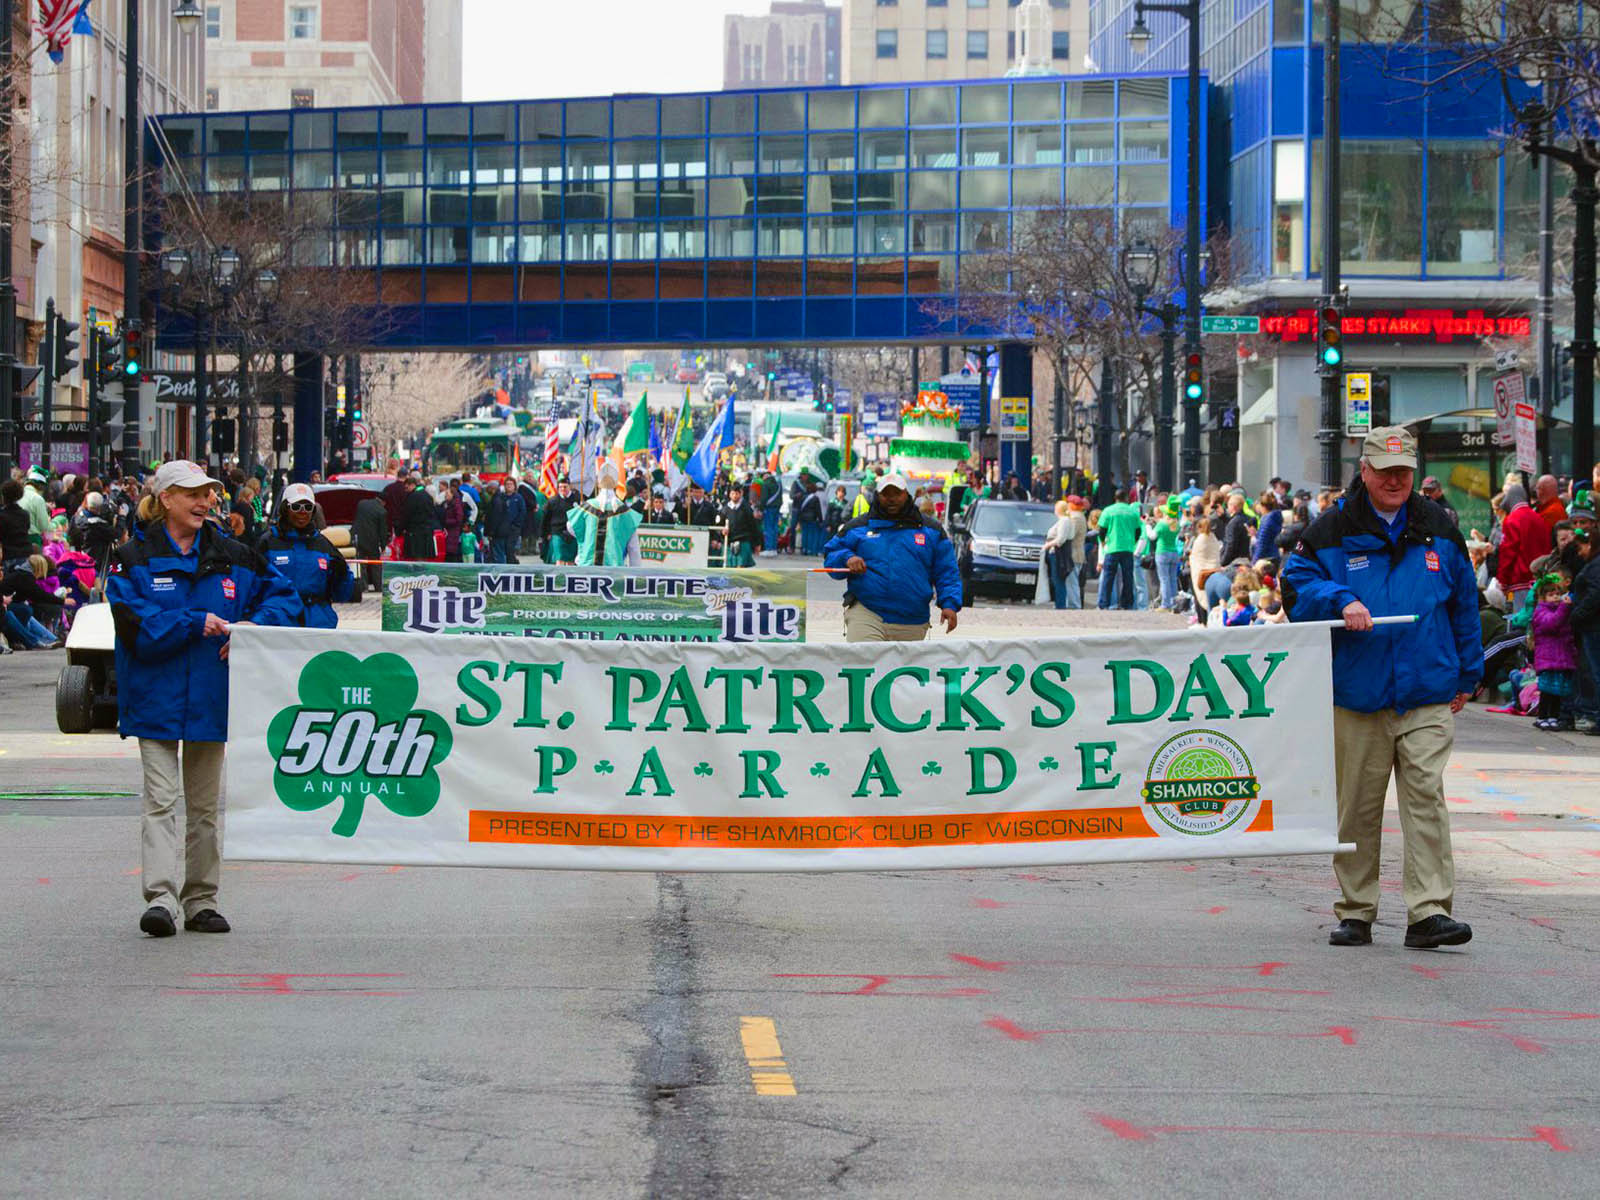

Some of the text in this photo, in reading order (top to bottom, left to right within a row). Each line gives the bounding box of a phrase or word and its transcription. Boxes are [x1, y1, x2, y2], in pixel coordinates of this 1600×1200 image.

[1462, 433, 1499, 446] 3rd S
[640, 537, 686, 550] MROCK
[643, 551, 661, 559] LUB
[392, 578, 435, 600] Miller
[479, 574, 707, 602] MILLER LITE
[408, 588, 484, 633] Lite
[710, 590, 746, 610] Miller
[513, 609, 685, 622] PROUD SPONSOR OF
[721, 601, 797, 642] Lite
[342, 687, 372, 704] THE
[456, 652, 1289, 734] ST. PATRICK'S DAY
[276, 708, 438, 778] 50th
[1155, 737, 1246, 774] MILWAUKEE WISCONSIN
[304, 781, 405, 795] ANNUAL
[1152, 781, 1250, 799] SHAMROCK
[1162, 806, 1217, 829] ESTABLISHED
[1184, 803, 1218, 811] CLUB
[490, 817, 1124, 842] PRESENTED BY THE SHAMROCK CLUB OF WISCONSIN
